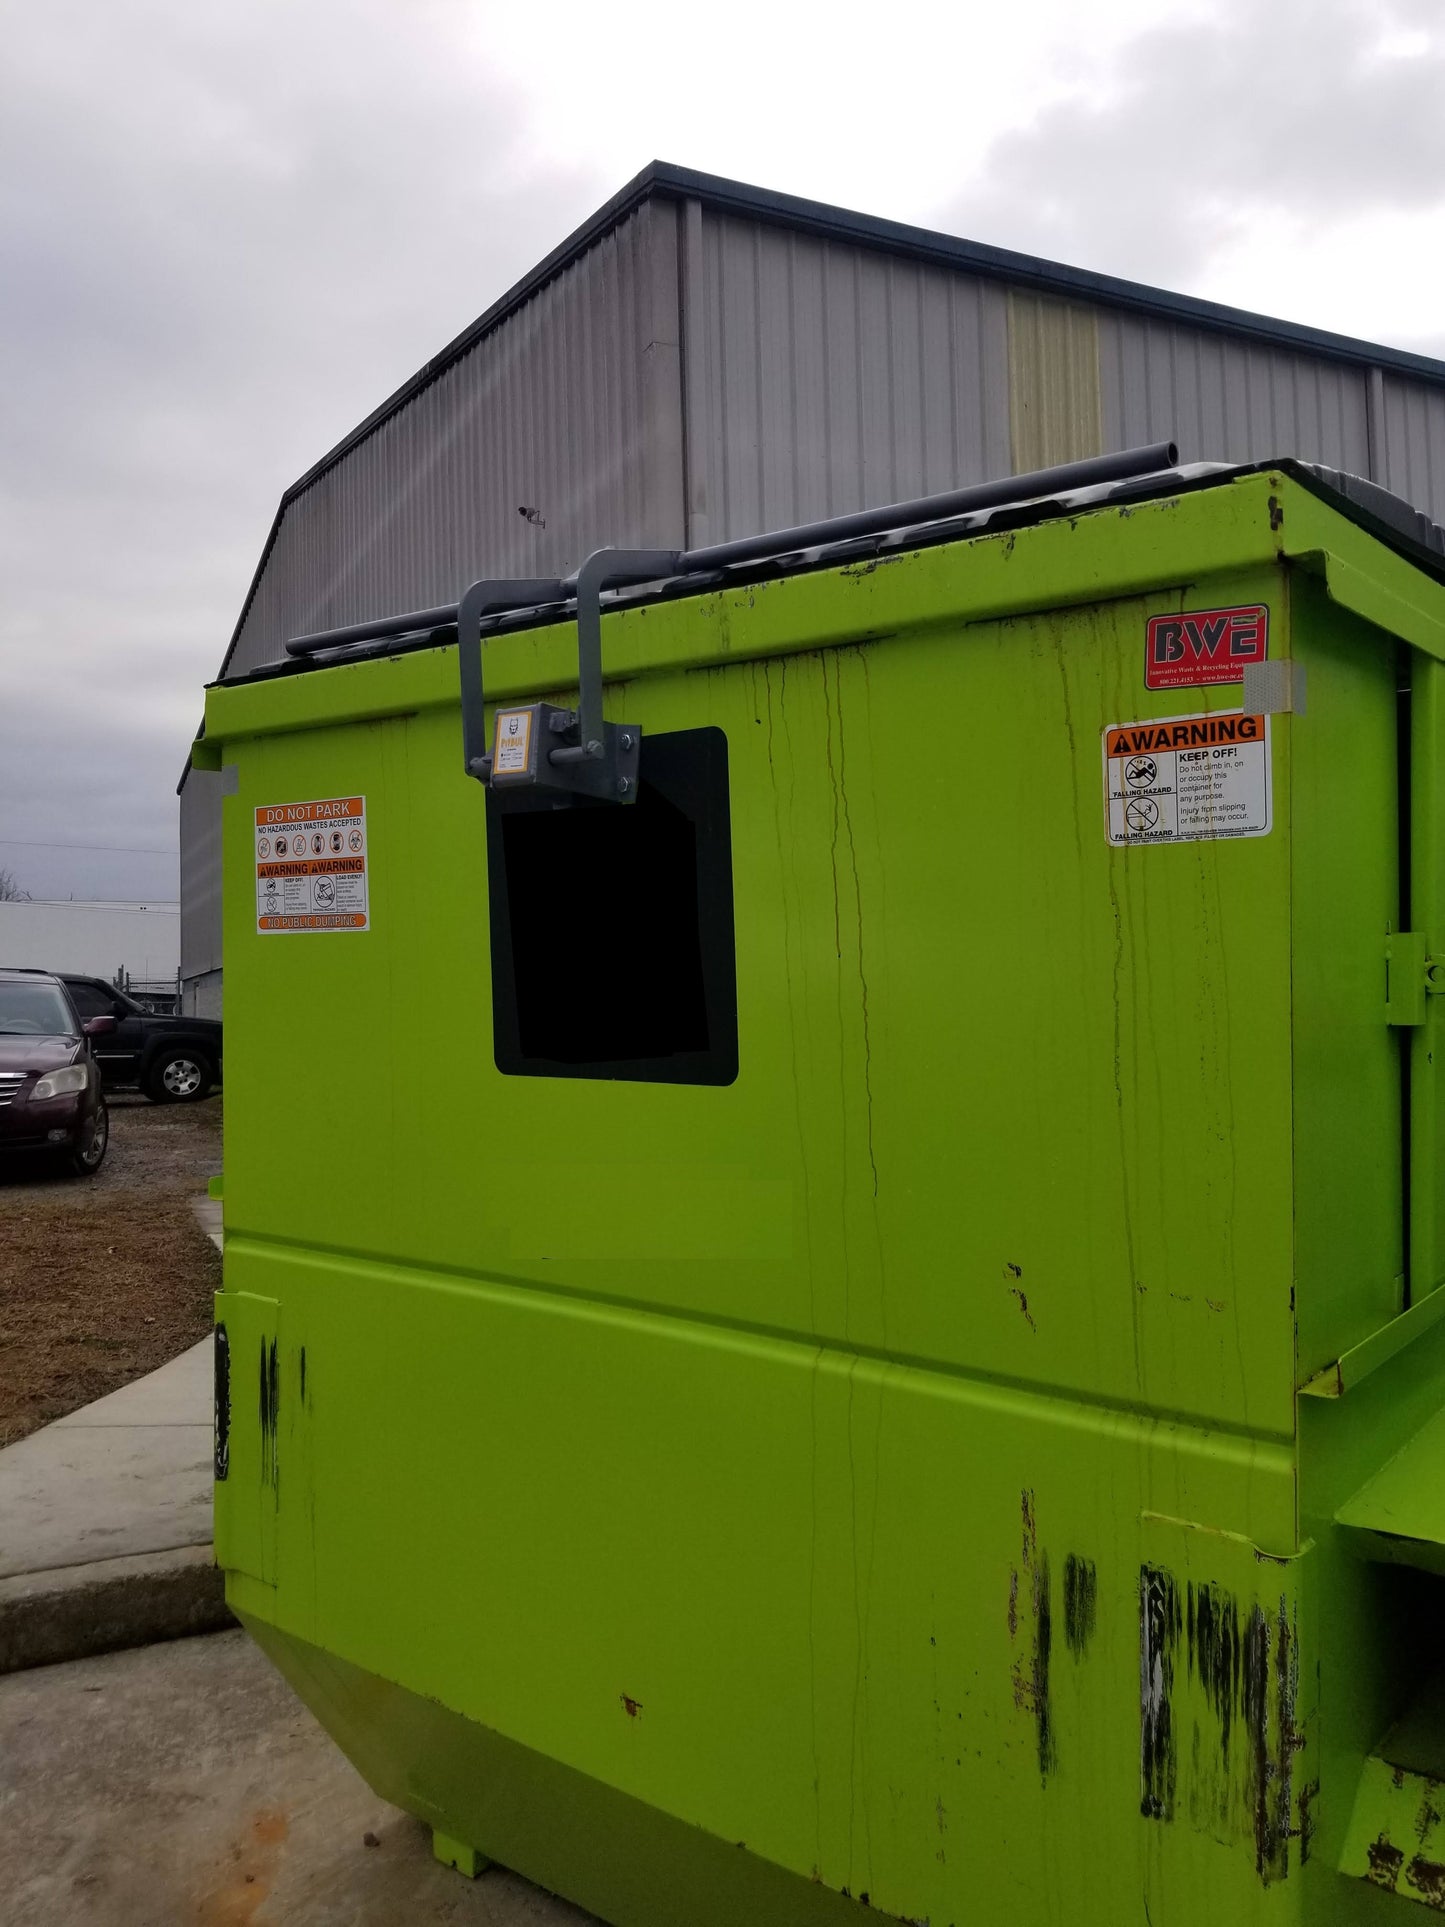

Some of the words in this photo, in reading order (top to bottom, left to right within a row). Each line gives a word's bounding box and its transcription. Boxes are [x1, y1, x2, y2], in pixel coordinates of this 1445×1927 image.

[1154, 614, 1258, 664] BWE
[1150, 667, 1177, 676] Innovative
[1202, 663, 1229, 672] Recycling
[1131, 718, 1256, 750] WARNING
[1180, 751, 1208, 762] KEEP
[1212, 748, 1237, 758] OFF!
[1114, 789, 1142, 798] FALLING
[1144, 786, 1172, 795] HAZARD
[1180, 784, 1212, 792] container
[1194, 793, 1224, 802] purpose.
[267, 809, 284, 822] DO
[288, 806, 312, 820] NOT
[316, 802, 350, 817] PARK
[1219, 804, 1246, 812] slipping
[268, 824, 302, 833] HAZARDOUS
[304, 821, 327, 830] WASTES
[329, 818, 361, 828] ACCEPTED
[266, 864, 308, 876] WARNING
[317, 860, 362, 873] WARNING
[268, 918, 280, 927] NO
[282, 917, 313, 927] PUBLIC
[316, 915, 356, 926] DUMPING
